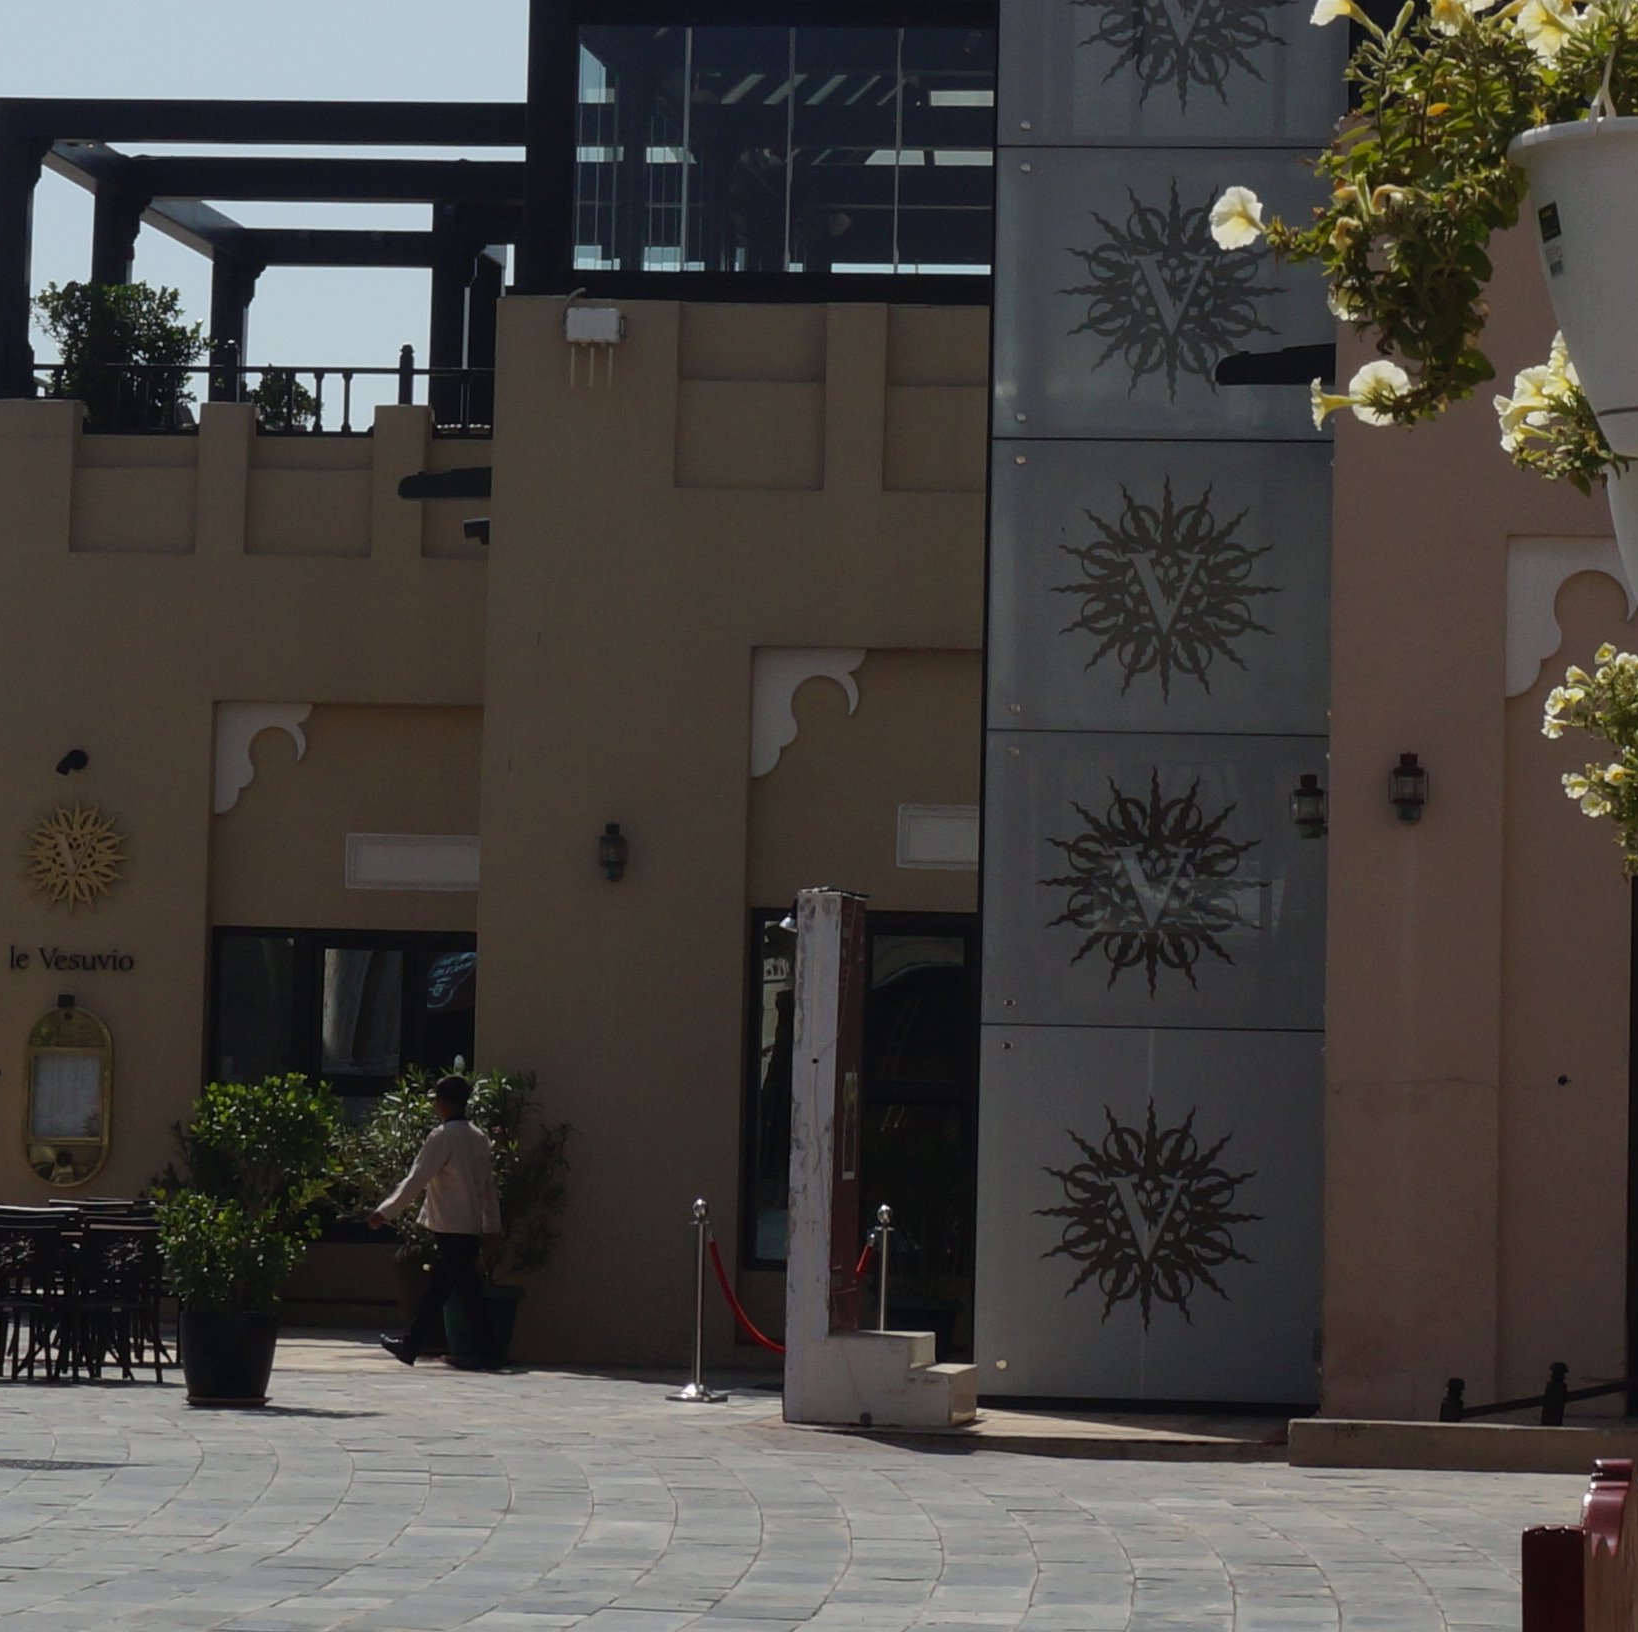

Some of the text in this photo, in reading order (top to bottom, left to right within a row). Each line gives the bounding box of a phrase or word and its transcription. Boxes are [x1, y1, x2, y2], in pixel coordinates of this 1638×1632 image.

[1136, 254, 1213, 336] V
[1128, 551, 1206, 634] V
[1115, 846, 1187, 929] V
[9, 944, 134, 971] le Vesuvio
[1110, 1176, 1186, 1264] V
